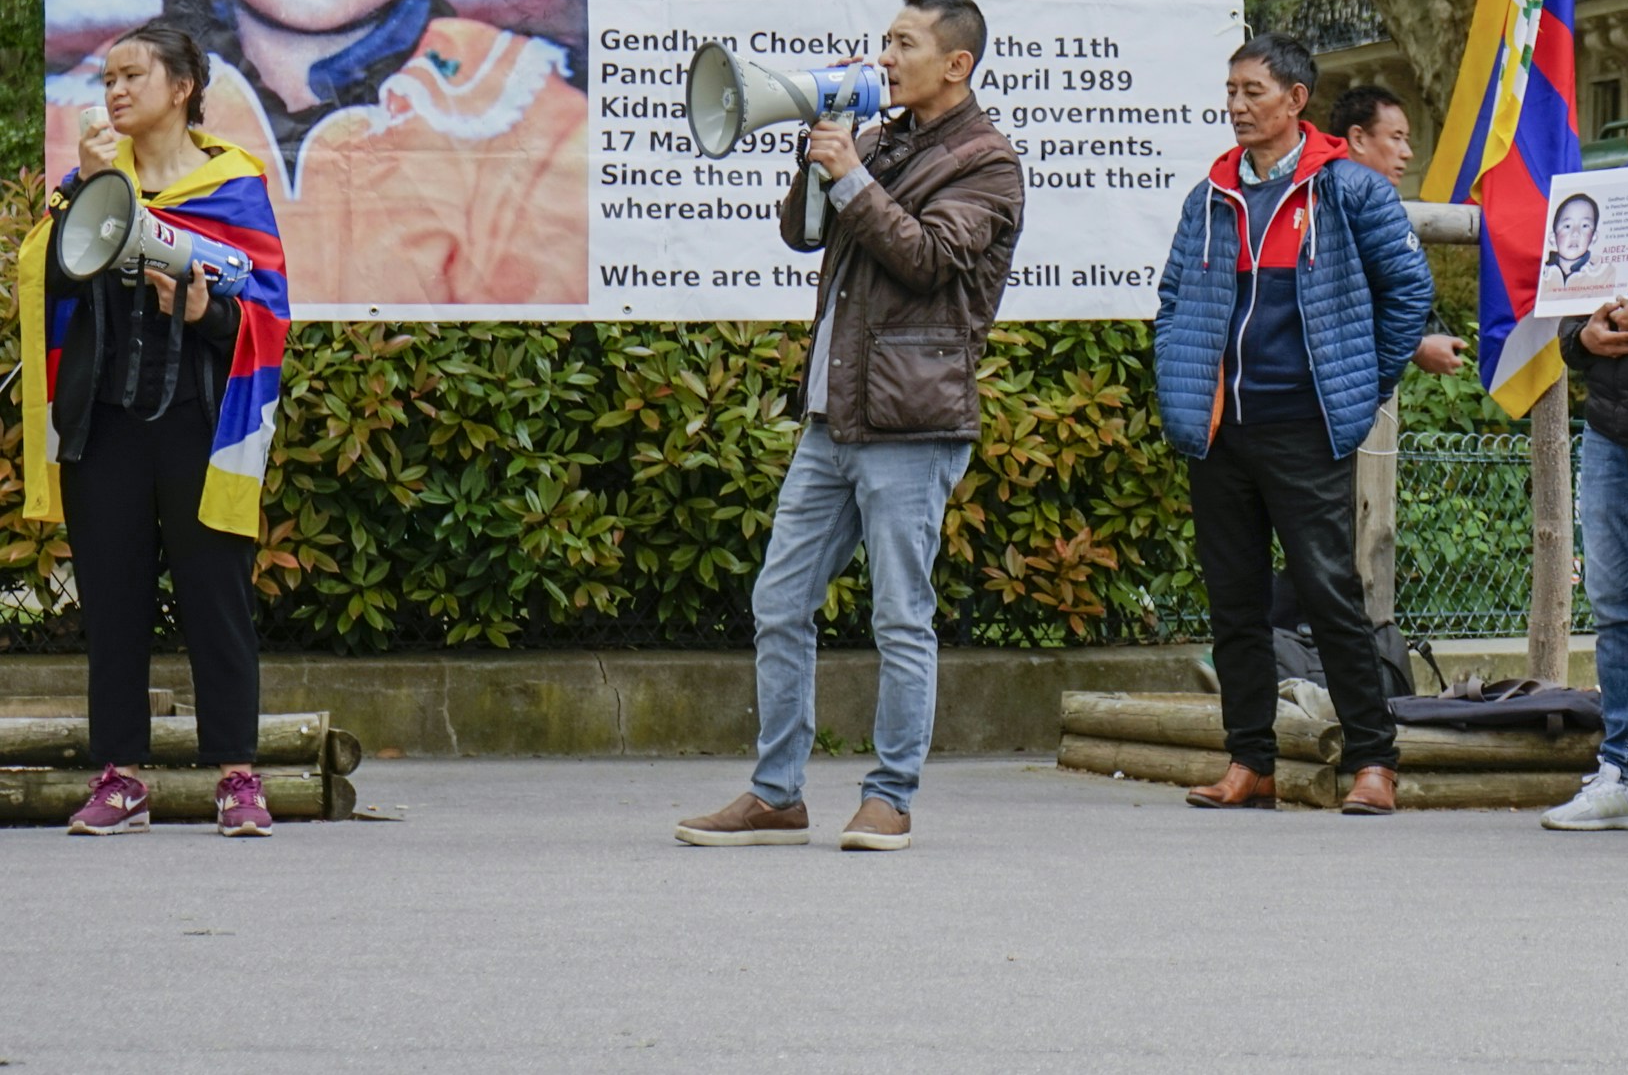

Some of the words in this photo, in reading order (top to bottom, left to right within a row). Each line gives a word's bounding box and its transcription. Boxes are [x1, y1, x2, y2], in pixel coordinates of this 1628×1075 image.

[600, 29, 738, 52] Gendhn
[751, 32, 869, 58] Choekyi
[994, 36, 1042, 57] the
[1055, 37, 1119, 58] 11th
[601, 63, 690, 85] Panch
[980, 69, 1049, 95] April
[1062, 70, 1133, 91] 1989
[601, 96, 687, 118] Kidna
[1012, 103, 1192, 128] government
[602, 131, 636, 151] 17
[731, 132, 794, 154] 995
[1040, 136, 1162, 161] parents.
[602, 163, 682, 186] Since
[693, 164, 762, 187] then
[1028, 166, 1096, 188] bout
[1106, 166, 1175, 189] their
[1600, 255, 1610, 264] LE
[600, 264, 700, 287] Where
[712, 269, 762, 287] are
[1007, 265, 1060, 287] still
[1072, 265, 1156, 287] alive?
